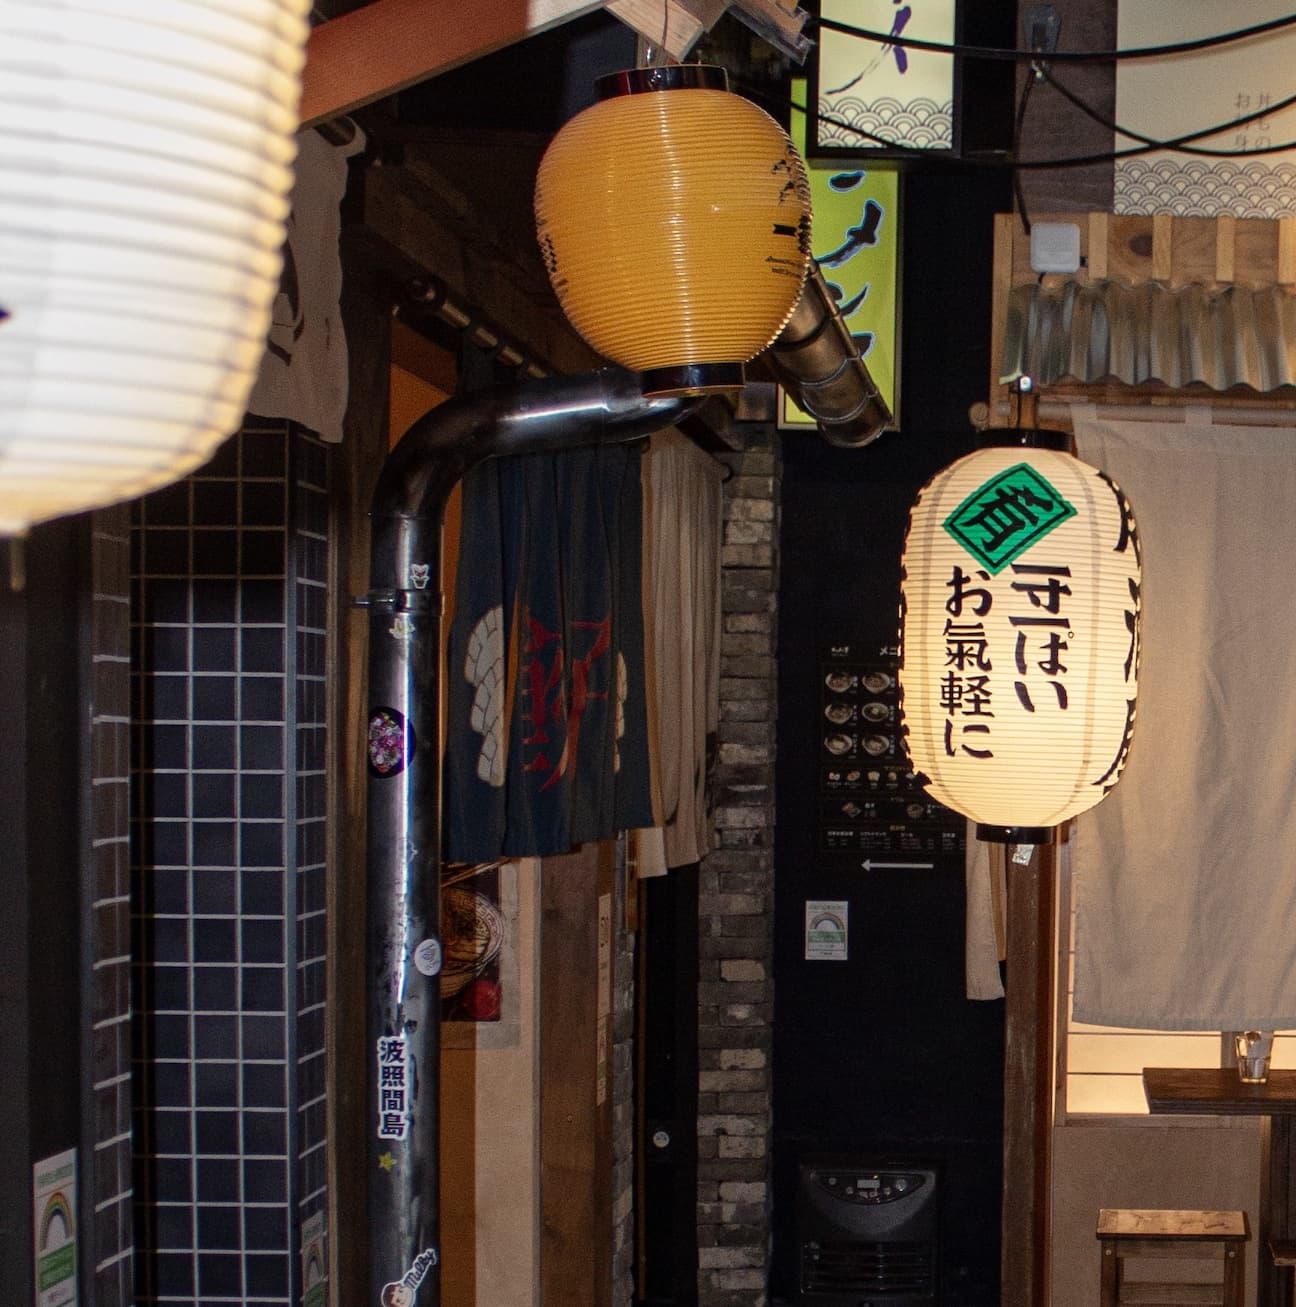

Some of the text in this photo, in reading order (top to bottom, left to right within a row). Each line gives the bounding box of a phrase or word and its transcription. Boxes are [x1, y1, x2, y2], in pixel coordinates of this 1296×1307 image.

[940, 565, 995, 758] お氣軽に
[1008, 563, 1074, 712] 一寸一ぱい
[380, 1040, 405, 1137] 波照間島
